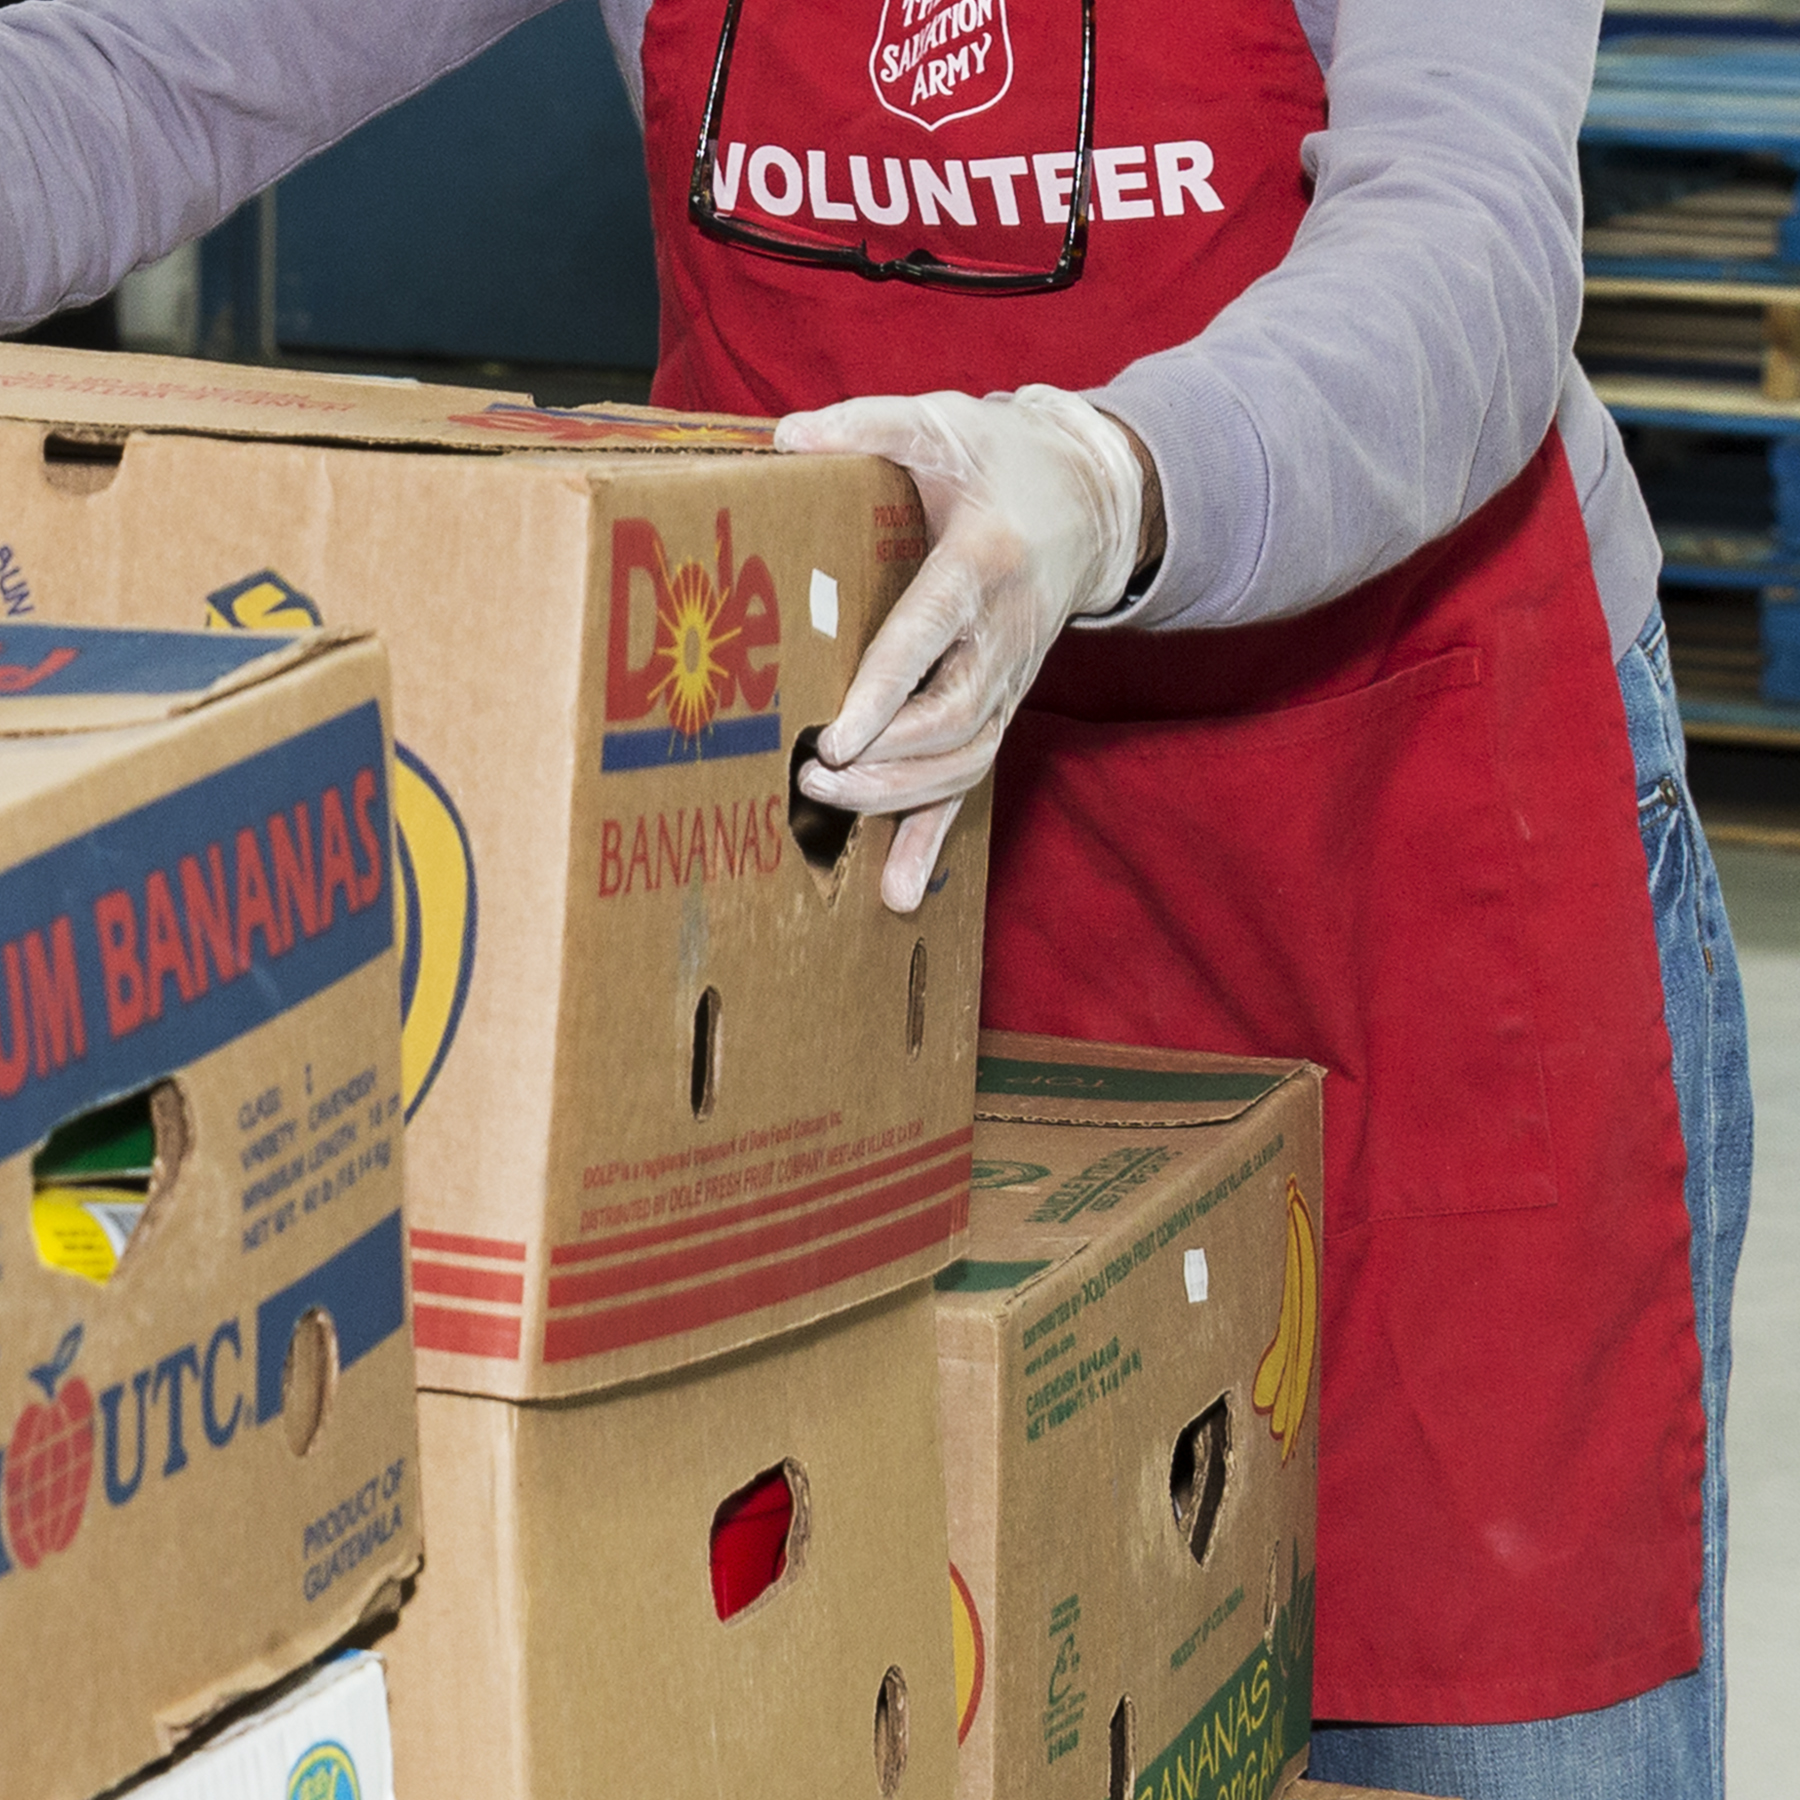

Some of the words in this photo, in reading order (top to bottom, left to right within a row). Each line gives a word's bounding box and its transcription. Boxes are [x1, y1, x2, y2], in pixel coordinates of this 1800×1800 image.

[910, 32, 992, 107] ARMY
[708, 140, 1225, 227] VOLUNTEER
[604, 506, 782, 736] Dole
[597, 793, 784, 899] BANANAS
[93, 766, 385, 1042] BANANAS
[99, 1317, 246, 1506] UTC
[302, 1475, 381, 1560] PRODUCT
[382, 1455, 407, 1501] OF
[302, 1506, 402, 1602] GUATEMALA
[1137, 1658, 1271, 1800] ANANAS
